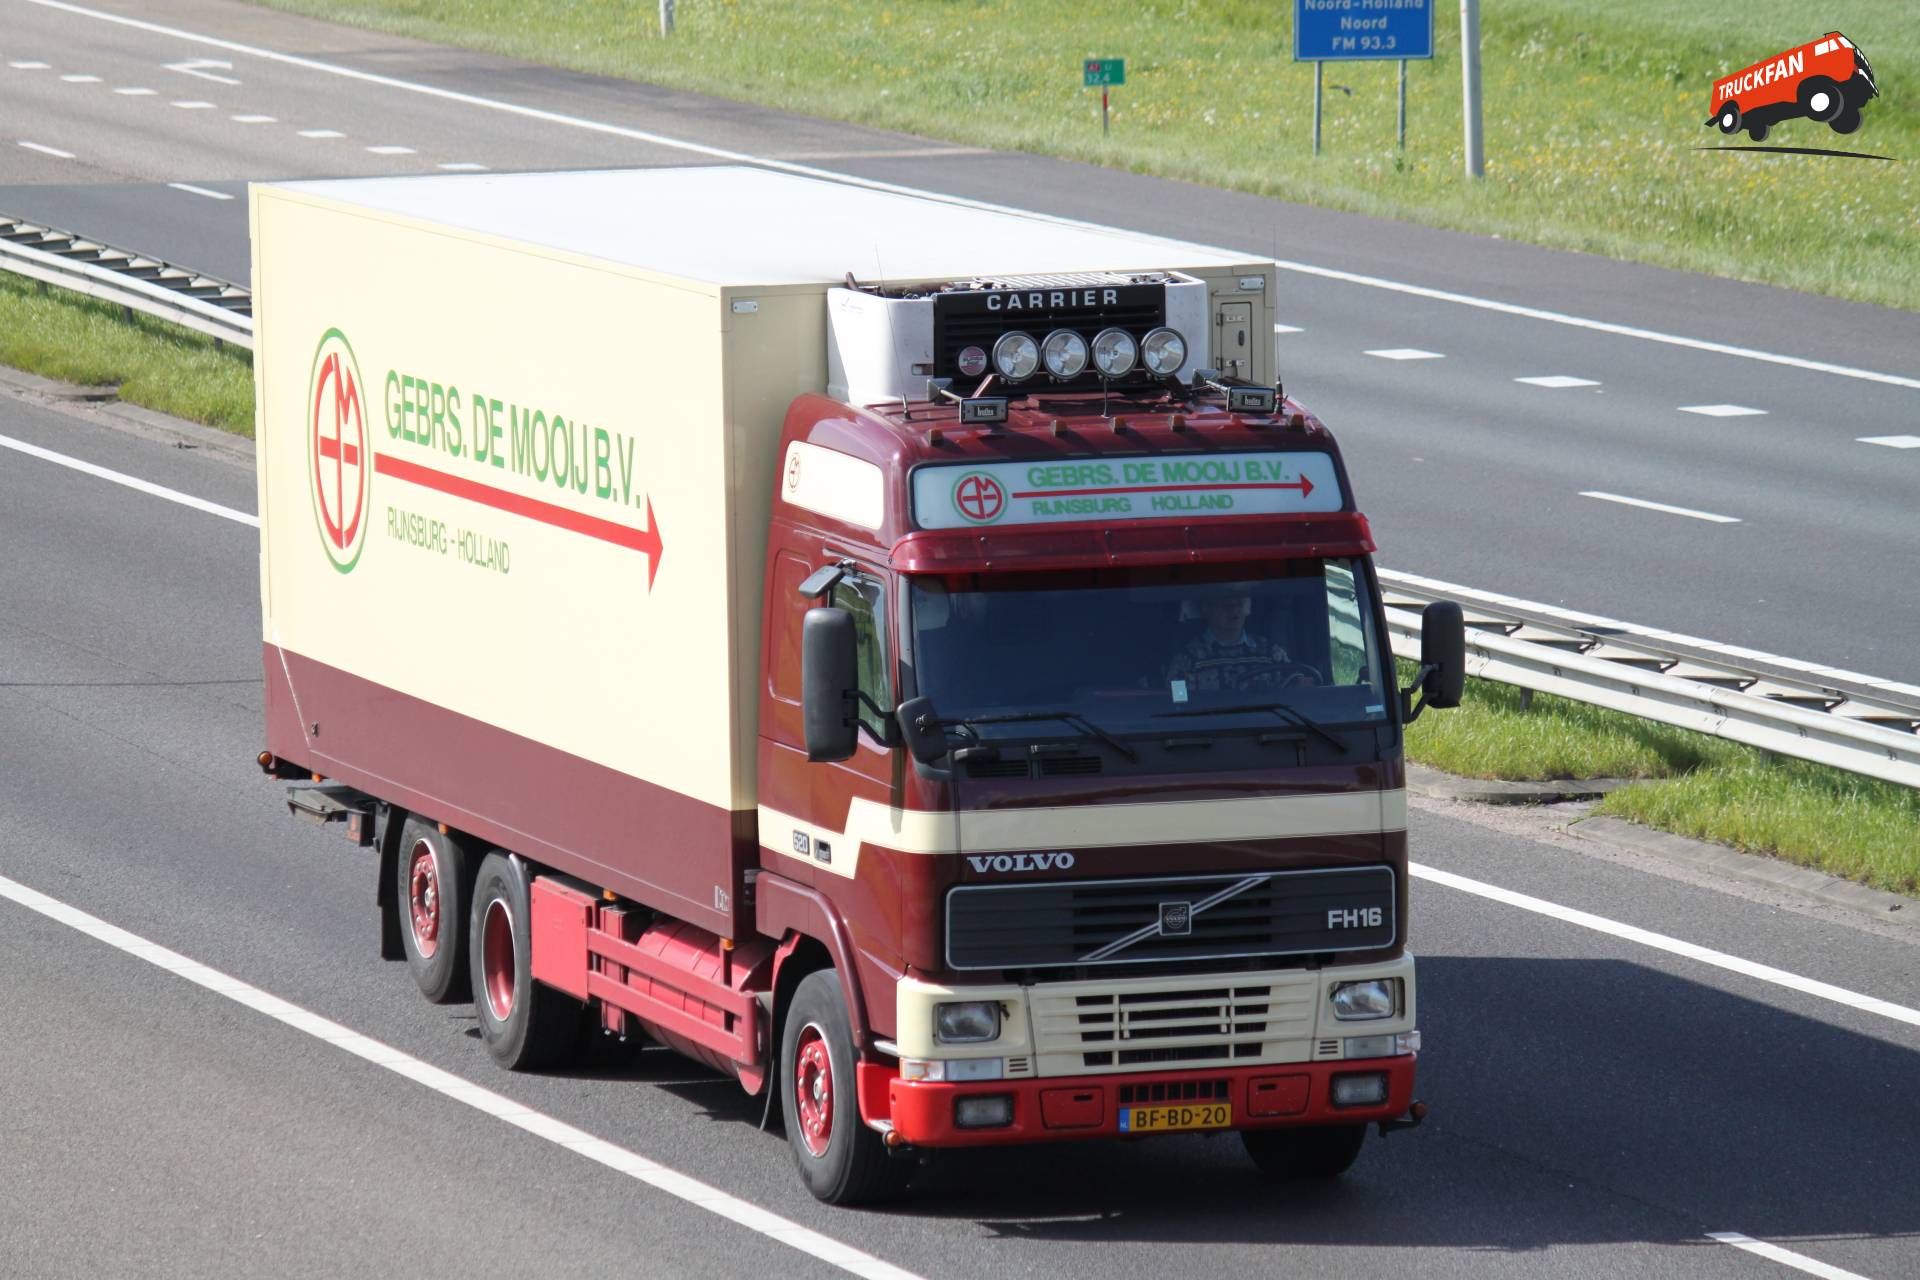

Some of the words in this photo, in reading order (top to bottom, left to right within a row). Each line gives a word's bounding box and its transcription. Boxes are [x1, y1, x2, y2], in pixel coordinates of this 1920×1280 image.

[1304, 0, 1425, 10] Noord-Holland
[1340, 16, 1388, 30] Noord
[1332, 37, 1356, 50] FM
[986, 289, 1117, 311] CARRIER
[385, 369, 468, 458] GEBRS.
[472, 393, 505, 469] DE
[510, 404, 588, 495] MOOIJ
[594, 427, 641, 509] B.V.
[1027, 464, 1120, 488] GEBRS.
[1123, 463, 1157, 483] DE
[1162, 461, 1241, 482] MOOIJ
[1245, 461, 1290, 481] B.V.
[1032, 497, 1132, 516] RIJNSBURG
[1151, 494, 1234, 511] HOLLAND
[387, 506, 448, 555] RIJNSBURG
[457, 528, 510, 574] HOLLAND
[966, 852, 1075, 873] VOLVO
[1328, 907, 1382, 929] FH16
[1136, 1107, 1226, 1128] BF-BD-20
